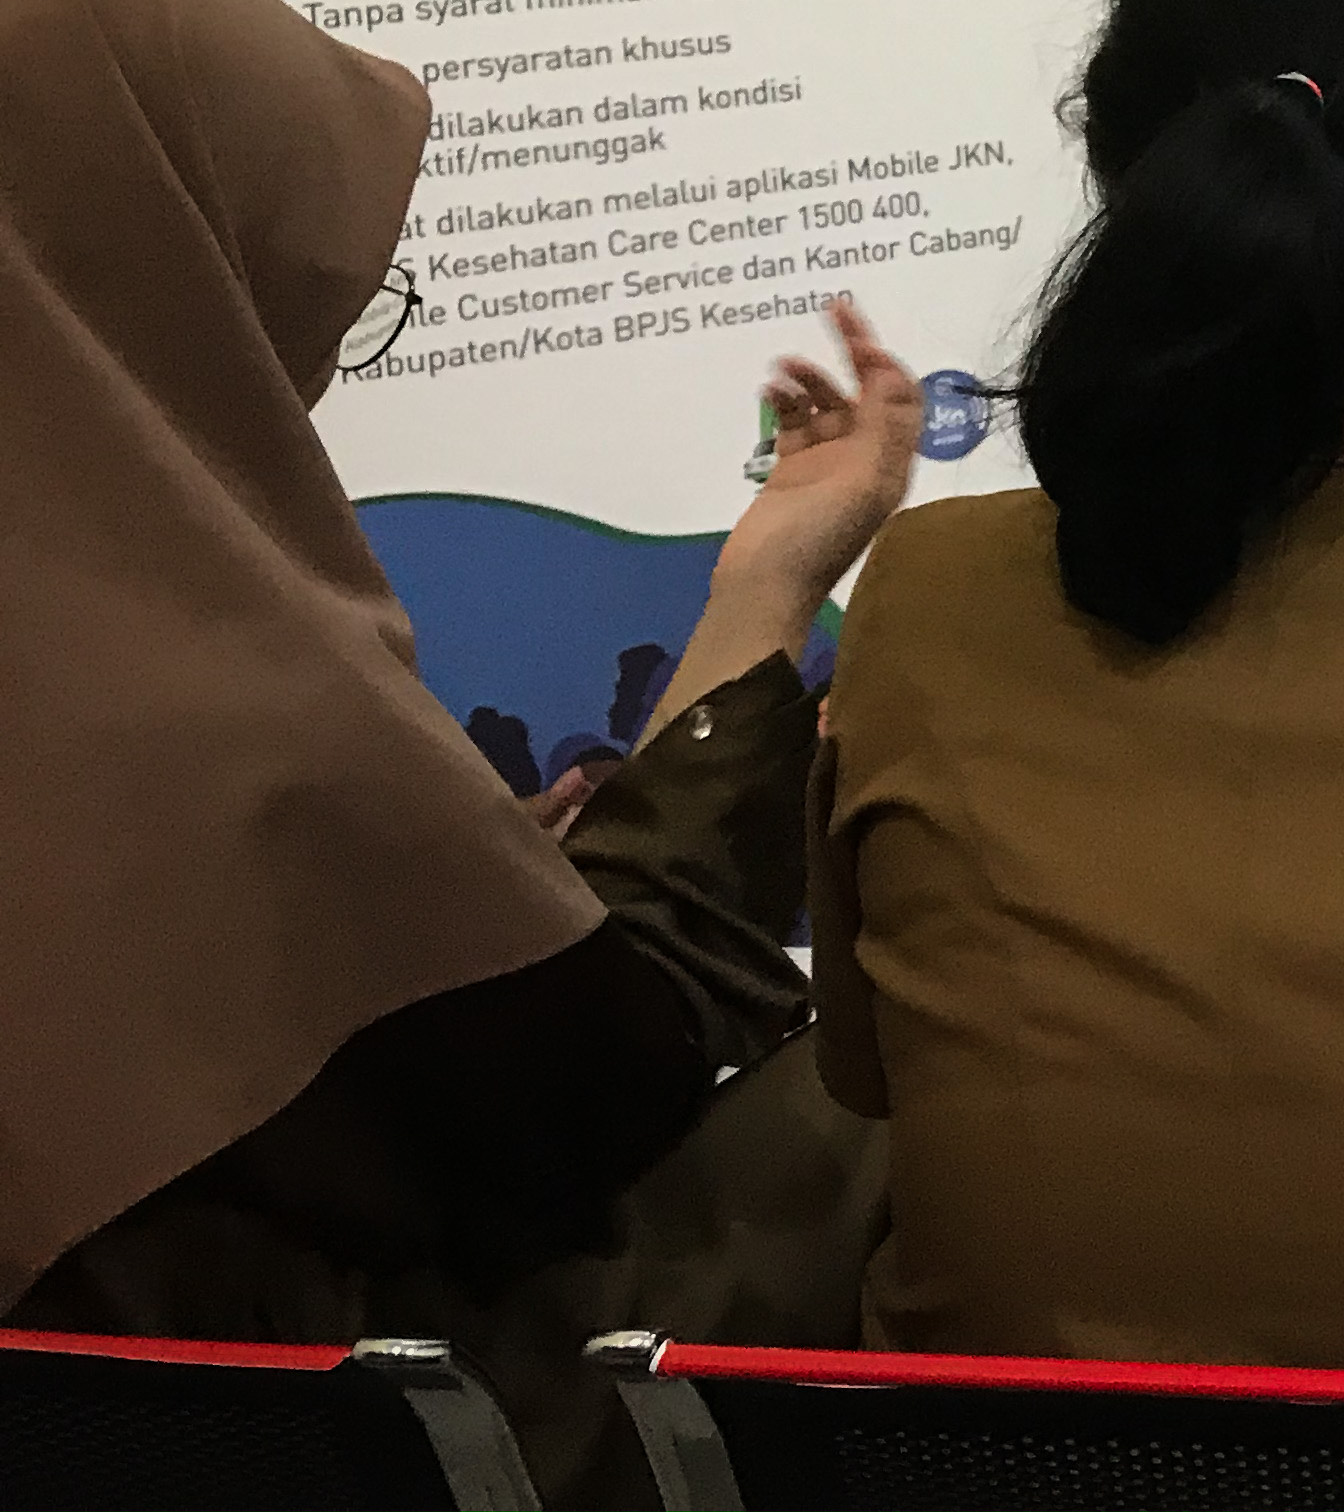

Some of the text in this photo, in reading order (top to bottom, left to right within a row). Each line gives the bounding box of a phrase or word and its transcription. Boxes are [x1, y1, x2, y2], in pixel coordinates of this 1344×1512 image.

[304, 0, 405, 34] Tanpa
[422, 34, 732, 90] persyaratan khusus
[428, 79, 802, 142] dilakukan dalam kondisi
[419, 124, 666, 178] ktif/menunggak
[436, 197, 593, 236] dilakukan
[603, 179, 717, 214] melalui
[726, 166, 838, 203] aplikasi
[847, 150, 939, 183] Mobile
[428, 240, 598, 282] Kesehatan
[607, 229, 679, 257] Care
[687, 215, 788, 246] Center
[798, 198, 864, 231] 1500
[457, 281, 614, 322] Customer
[622, 265, 734, 298] Service
[742, 254, 796, 281] dan
[804, 241, 901, 271] Kantor
[909, 215, 1023, 257] Cabang/
[613, 306, 691, 343] BPJS
